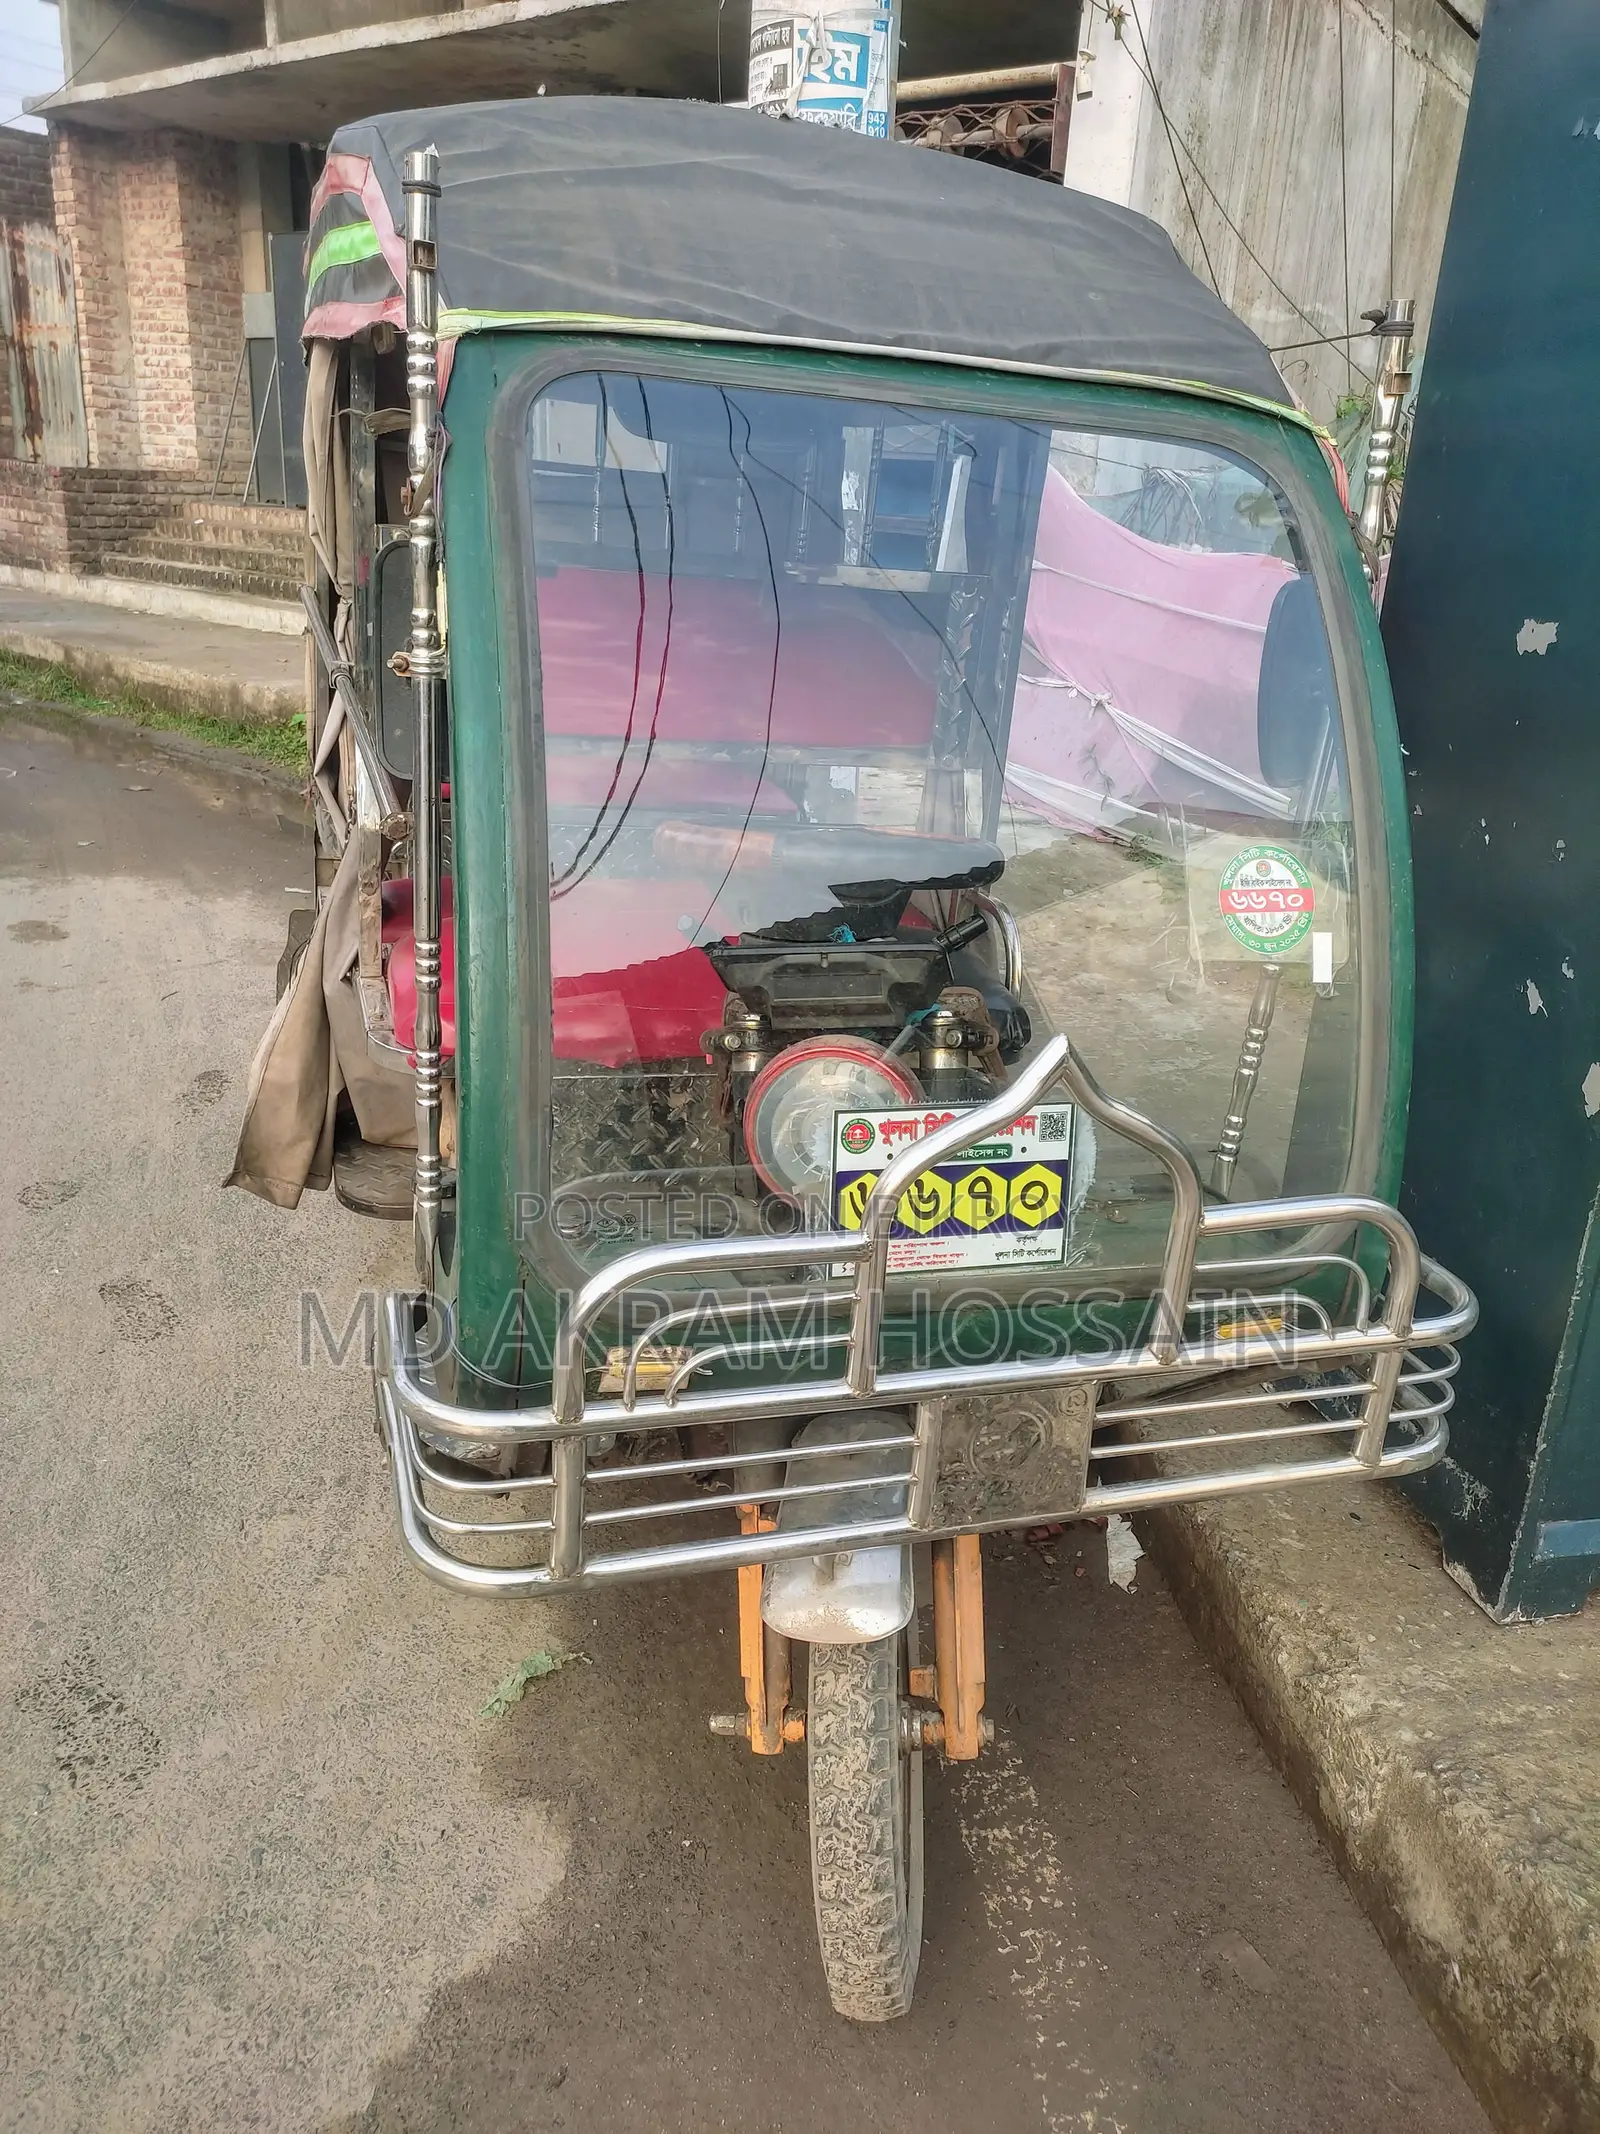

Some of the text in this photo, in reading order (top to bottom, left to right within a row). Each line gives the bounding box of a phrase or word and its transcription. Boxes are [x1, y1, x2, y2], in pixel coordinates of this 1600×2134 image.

[867, 113, 886, 124] 943
[867, 126, 886, 138] 910
[1228, 891, 1304, 910] ৬৬৭০
[879, 1116, 921, 1147] খুলনা
[997, 1147, 1009, 1158] নং
